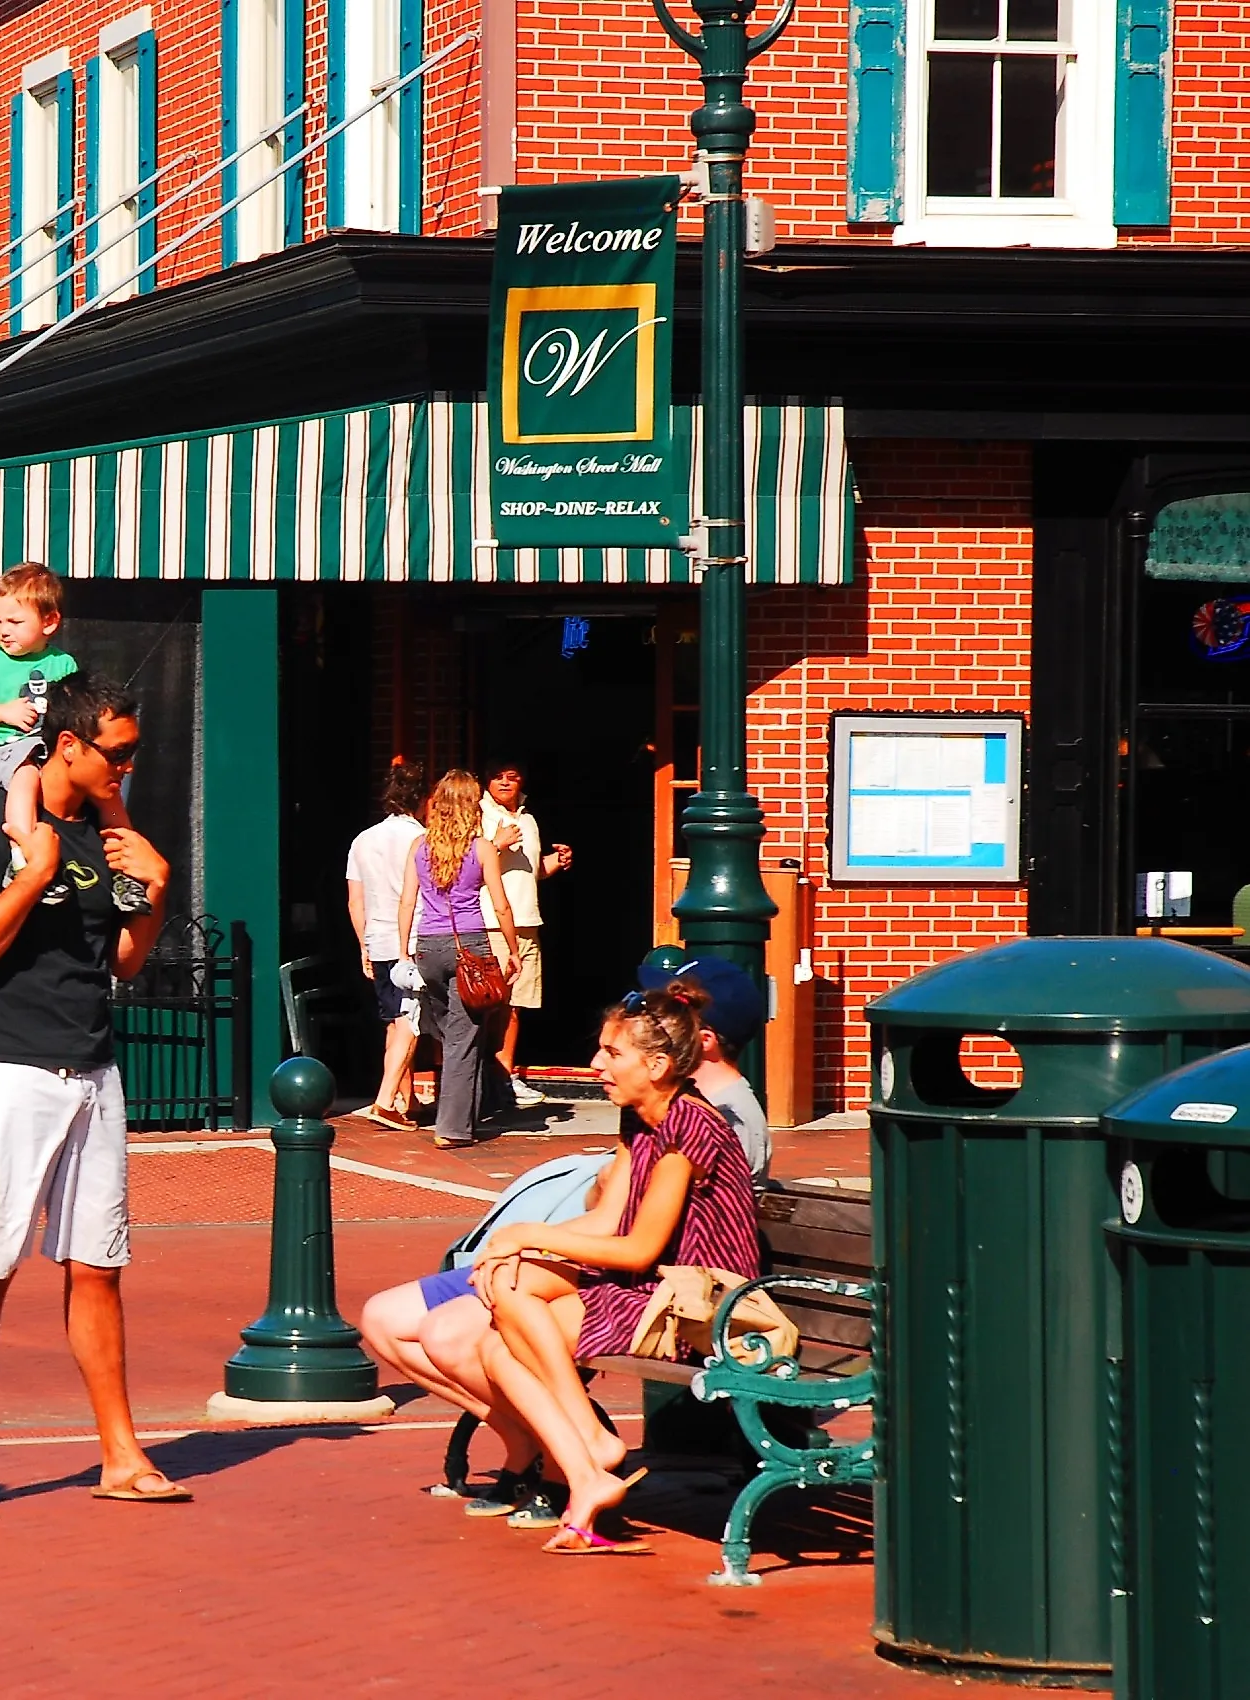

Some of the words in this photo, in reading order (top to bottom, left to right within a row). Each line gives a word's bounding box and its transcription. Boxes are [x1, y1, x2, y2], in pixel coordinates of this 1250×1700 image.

[516, 221, 662, 254] Welcome
[523, 316, 667, 397] W
[495, 454, 573, 482] Washington
[575, 455, 619, 476] Street
[620, 453, 663, 474] Mall
